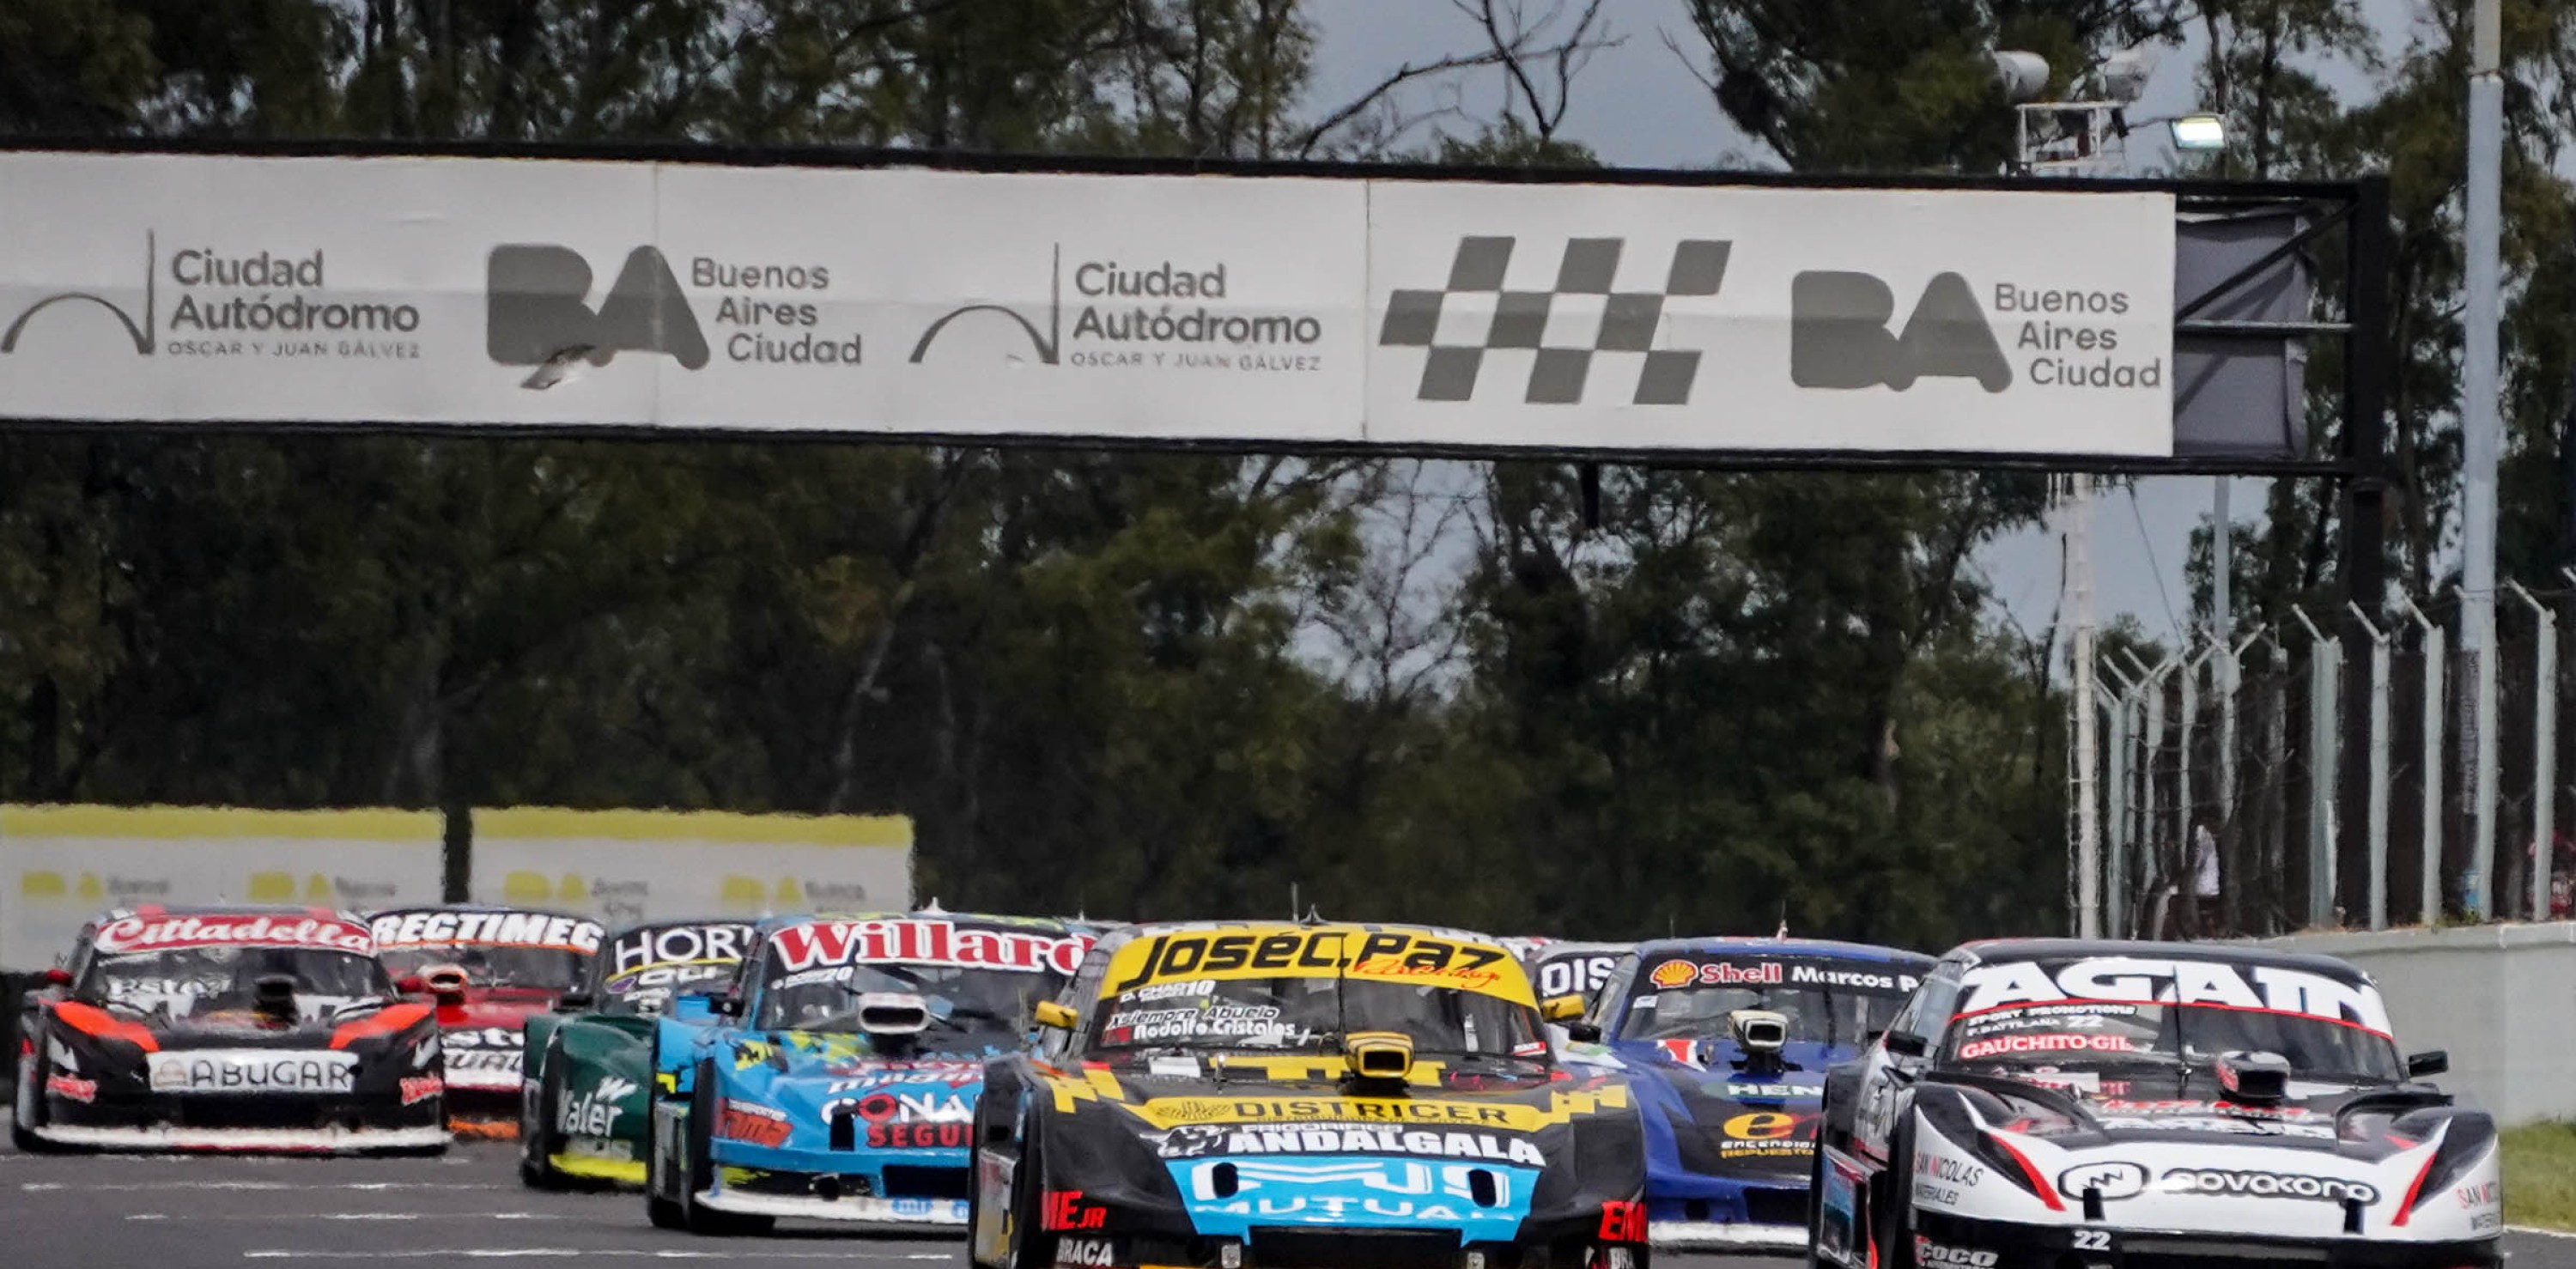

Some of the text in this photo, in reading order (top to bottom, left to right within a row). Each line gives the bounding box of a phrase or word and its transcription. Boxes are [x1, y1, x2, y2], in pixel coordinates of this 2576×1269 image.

[171, 249, 323, 288] Ciudad
[692, 257, 829, 289] Buenos
[1075, 262, 1226, 299] Ciudad
[169, 294, 420, 333] Autódromo
[716, 296, 817, 328] Aires
[1994, 282, 2129, 315] Buenos
[1072, 304, 1322, 344] Autódromo
[2017, 321, 2117, 351] Aires
[167, 340, 241, 357] OSCAR
[252, 341, 264, 356] Y
[272, 341, 327, 357] JUAN
[727, 331, 862, 365] Ciudad
[1071, 351, 1144, 367] OSCAR
[1153, 352, 1165, 367] Y
[1175, 353, 1231, 369] JUAN
[2029, 356, 2161, 389] Ciudad
[615, 924, 754, 974] HOR
[1700, 962, 1782, 984] Shell
[1791, 966, 1893, 989] Marcos
[191, 1060, 349, 1088] ABUGAR
[821, 1092, 977, 1126] CONA
[1234, 1102, 1510, 1125] DISTRICER
[1228, 1131, 1546, 1167] ANDALGALA
[2073, 1231, 2111, 1250] 22
